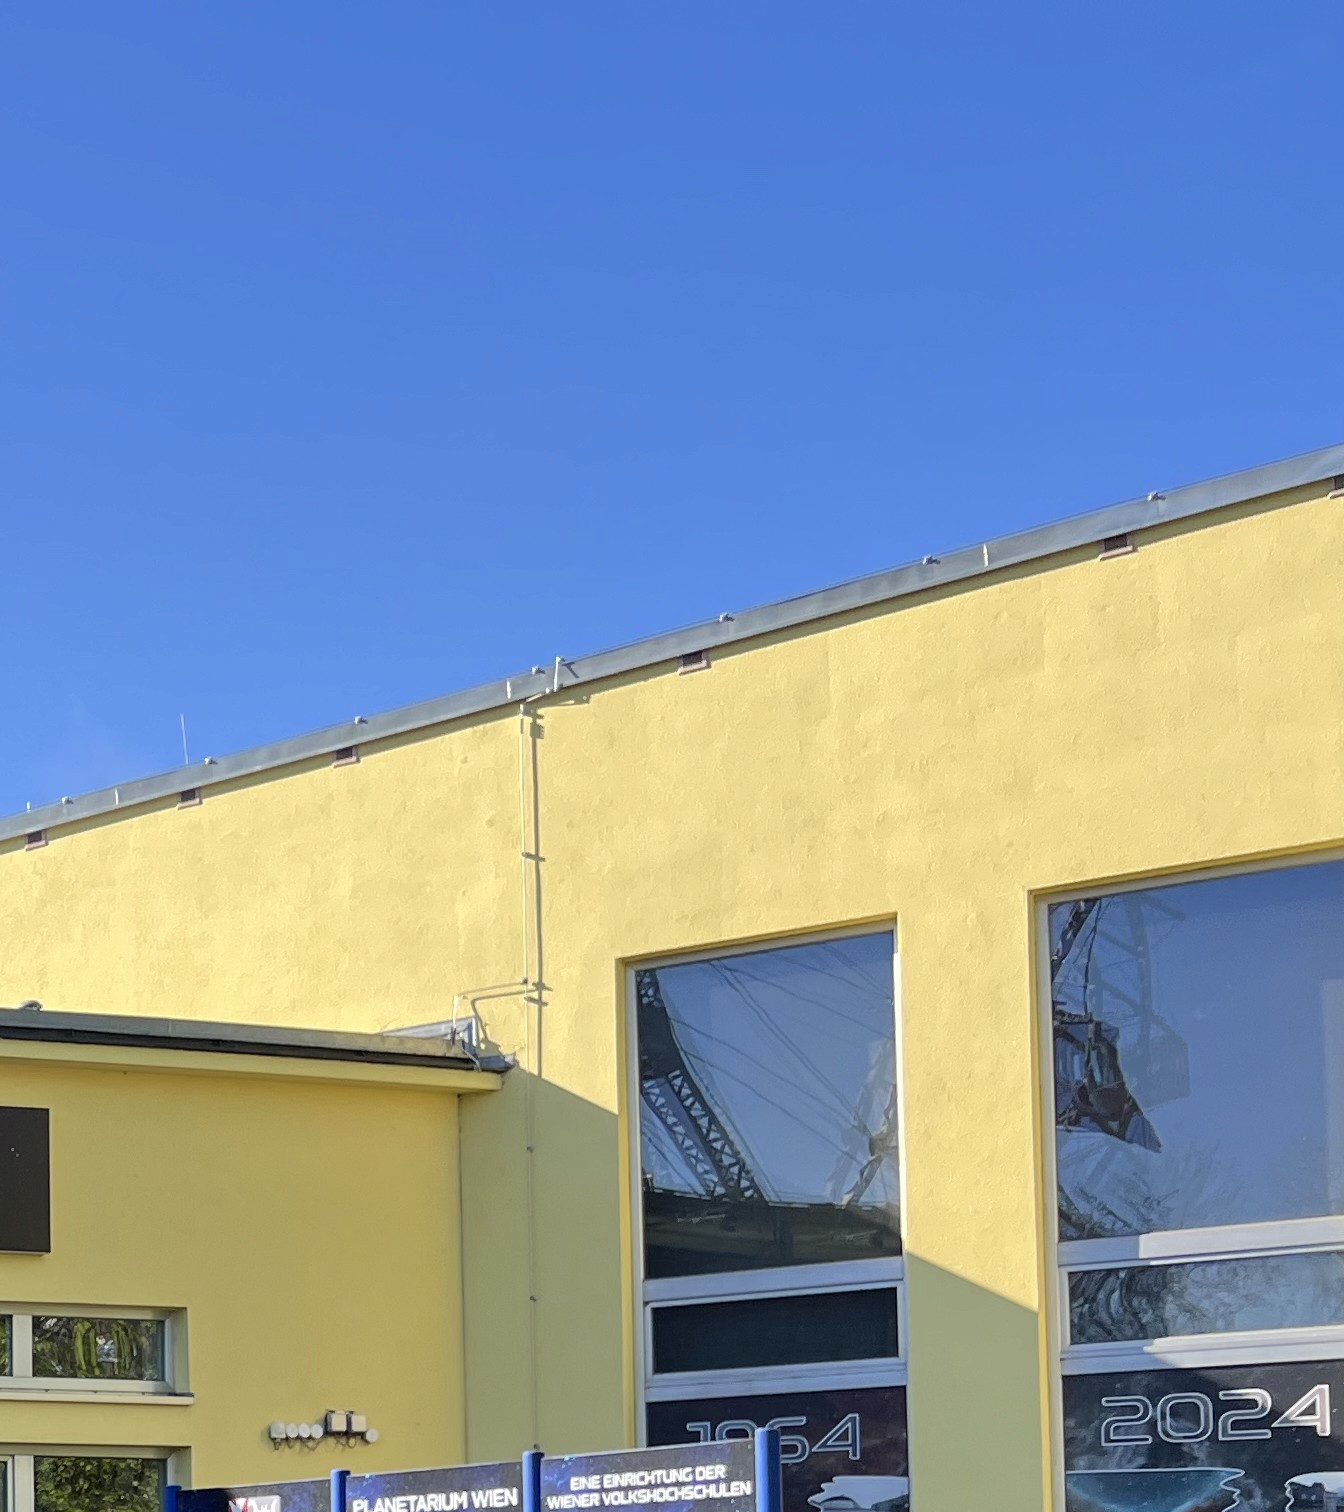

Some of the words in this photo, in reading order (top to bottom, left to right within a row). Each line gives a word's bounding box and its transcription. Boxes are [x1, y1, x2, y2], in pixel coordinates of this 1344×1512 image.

[1100, 1383, 1332, 1447] 2024
[570, 1475, 601, 1491] EINE
[603, 1466, 694, 1488] EINRICHTUNG
[695, 1464, 726, 1482] DER
[471, 1487, 519, 1509] WIEN
[547, 1493, 599, 1510] WIENER
[601, 1481, 752, 1506] VOLKSHOCHSCHULEN
